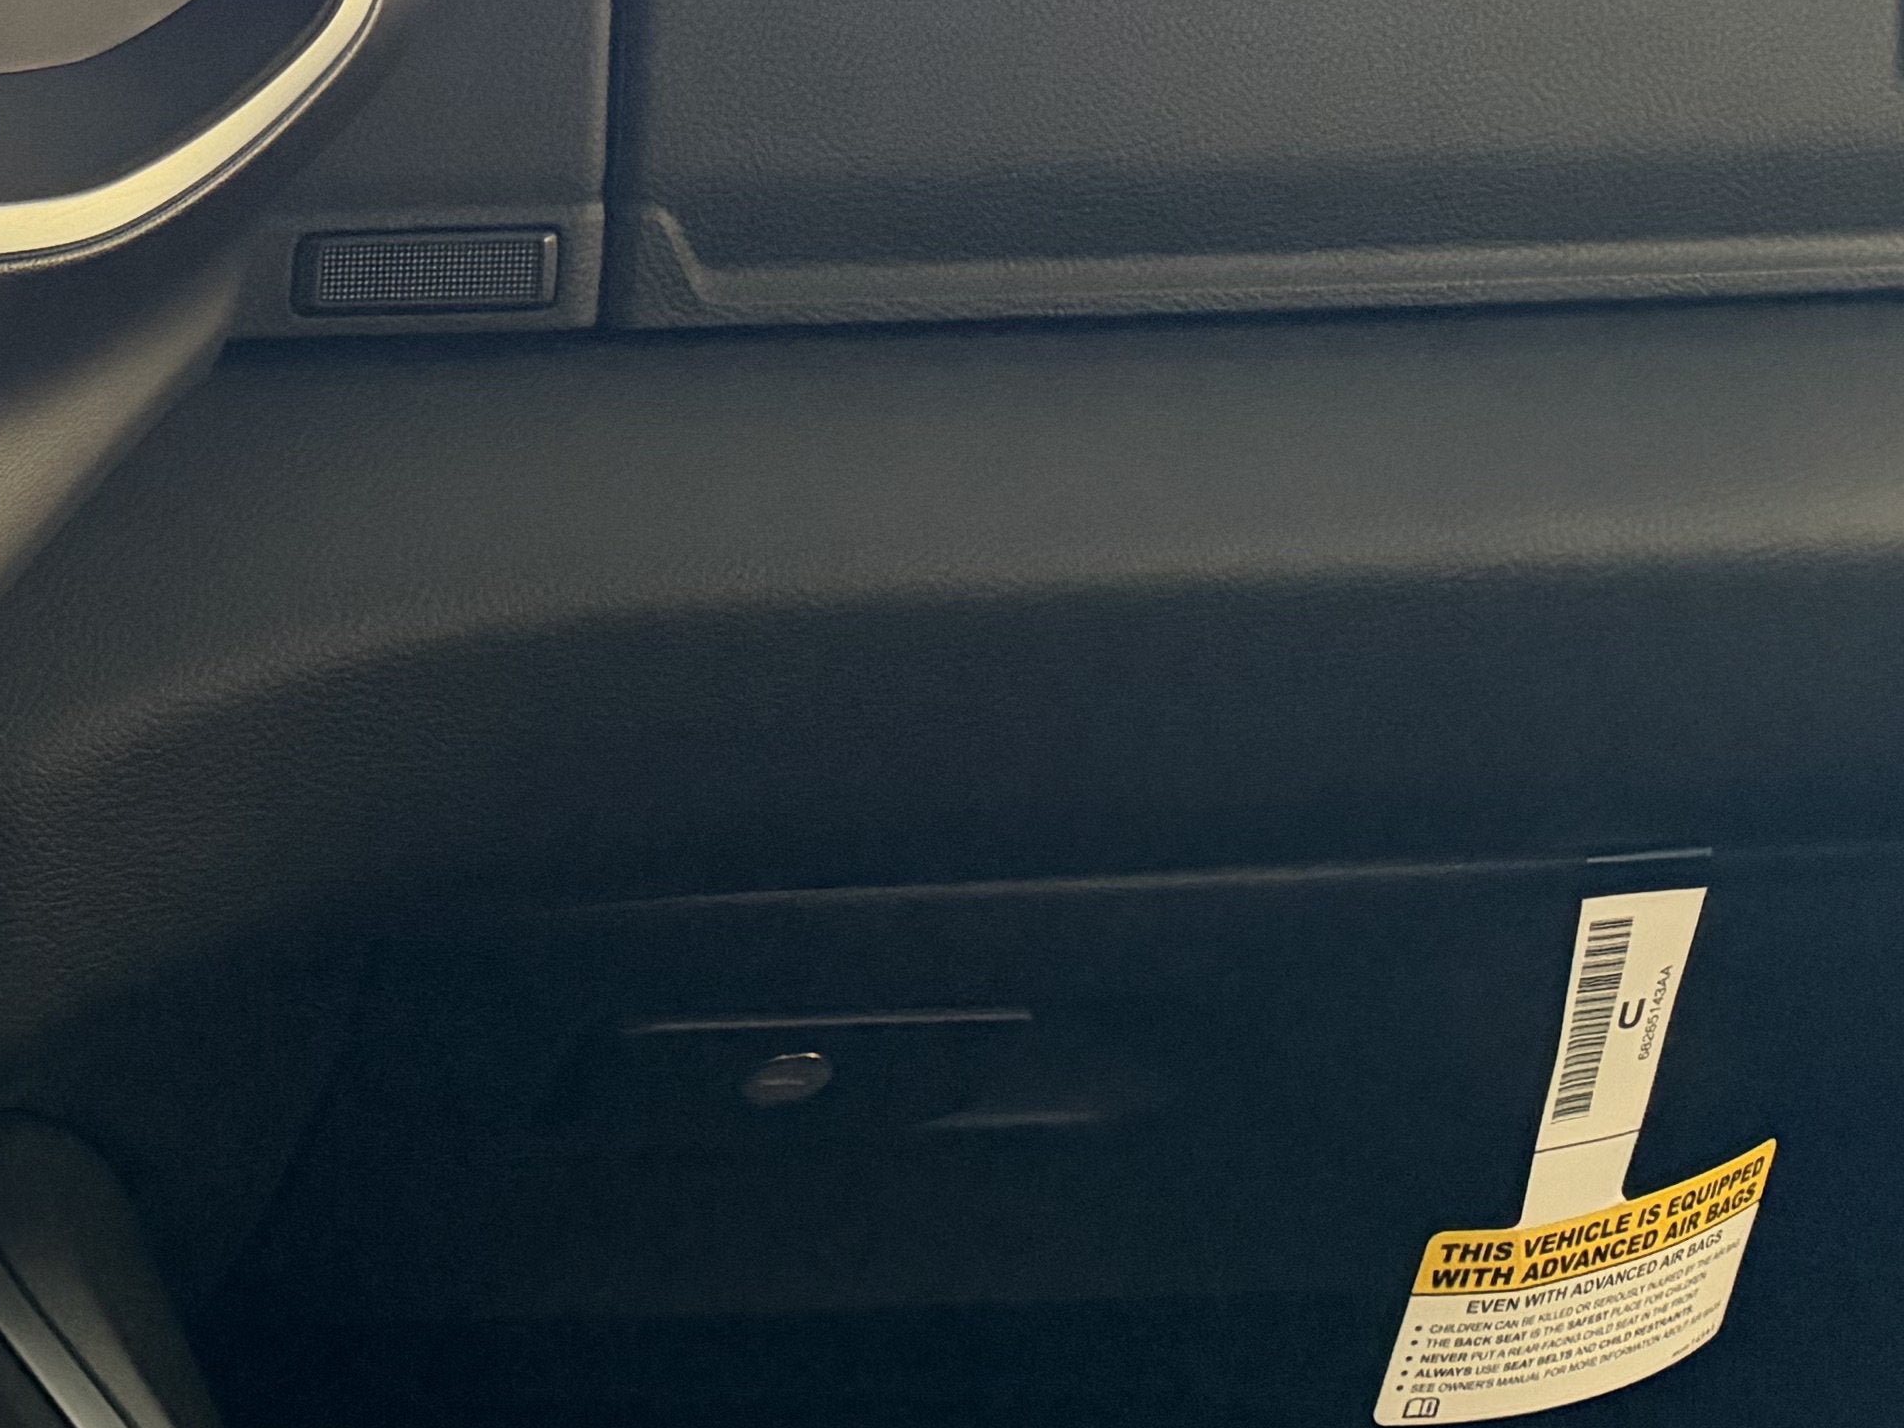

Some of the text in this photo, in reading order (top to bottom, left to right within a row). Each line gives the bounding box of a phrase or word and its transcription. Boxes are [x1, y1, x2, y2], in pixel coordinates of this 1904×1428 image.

[1619, 998, 1646, 1029] U
[1441, 1156, 1765, 1263] THIS VEHICLE IS EQUIPPED
[1431, 1183, 1757, 1289] WITH ADVANCED AIR BAGS
[1466, 1230, 1723, 1314] EVEN WITH ADVANCED AIR BAGS
[1426, 1338, 1451, 1348] THE
[1454, 1336, 1492, 1348] BACK
[1496, 1331, 1527, 1344] SEAT
[1429, 1318, 1519, 1336] CHILDREN CAN
[1414, 1367, 1472, 1379] ALWAYS
[1503, 1356, 1533, 1371] SEAT
[1420, 1349, 1468, 1363] NEVER
